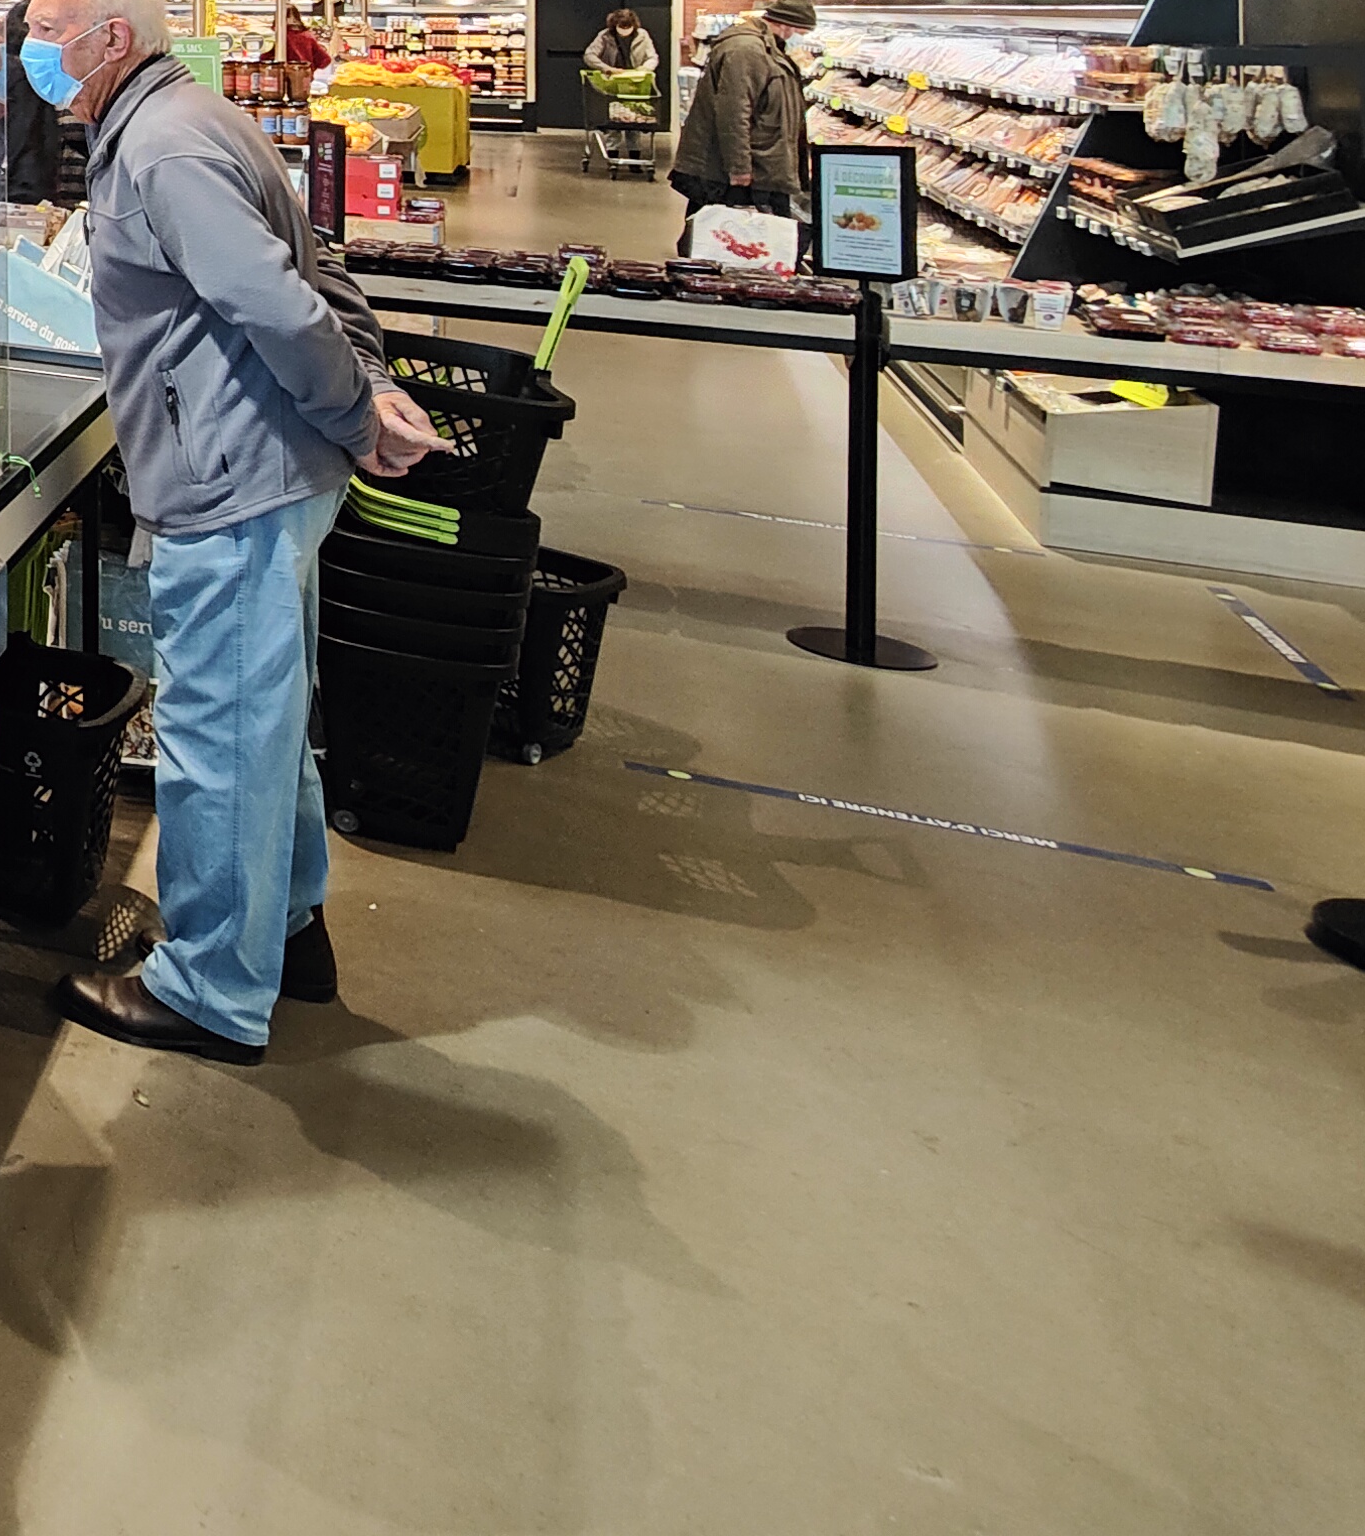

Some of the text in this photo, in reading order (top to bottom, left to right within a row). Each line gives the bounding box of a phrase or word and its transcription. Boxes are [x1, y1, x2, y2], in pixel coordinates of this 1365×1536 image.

[3, 304, 39, 332] service
[39, 325, 55, 342] du
[102, 616, 153, 635] u serv
[796, 792, 1059, 849] MERCI D'ATTENDRE ICI
